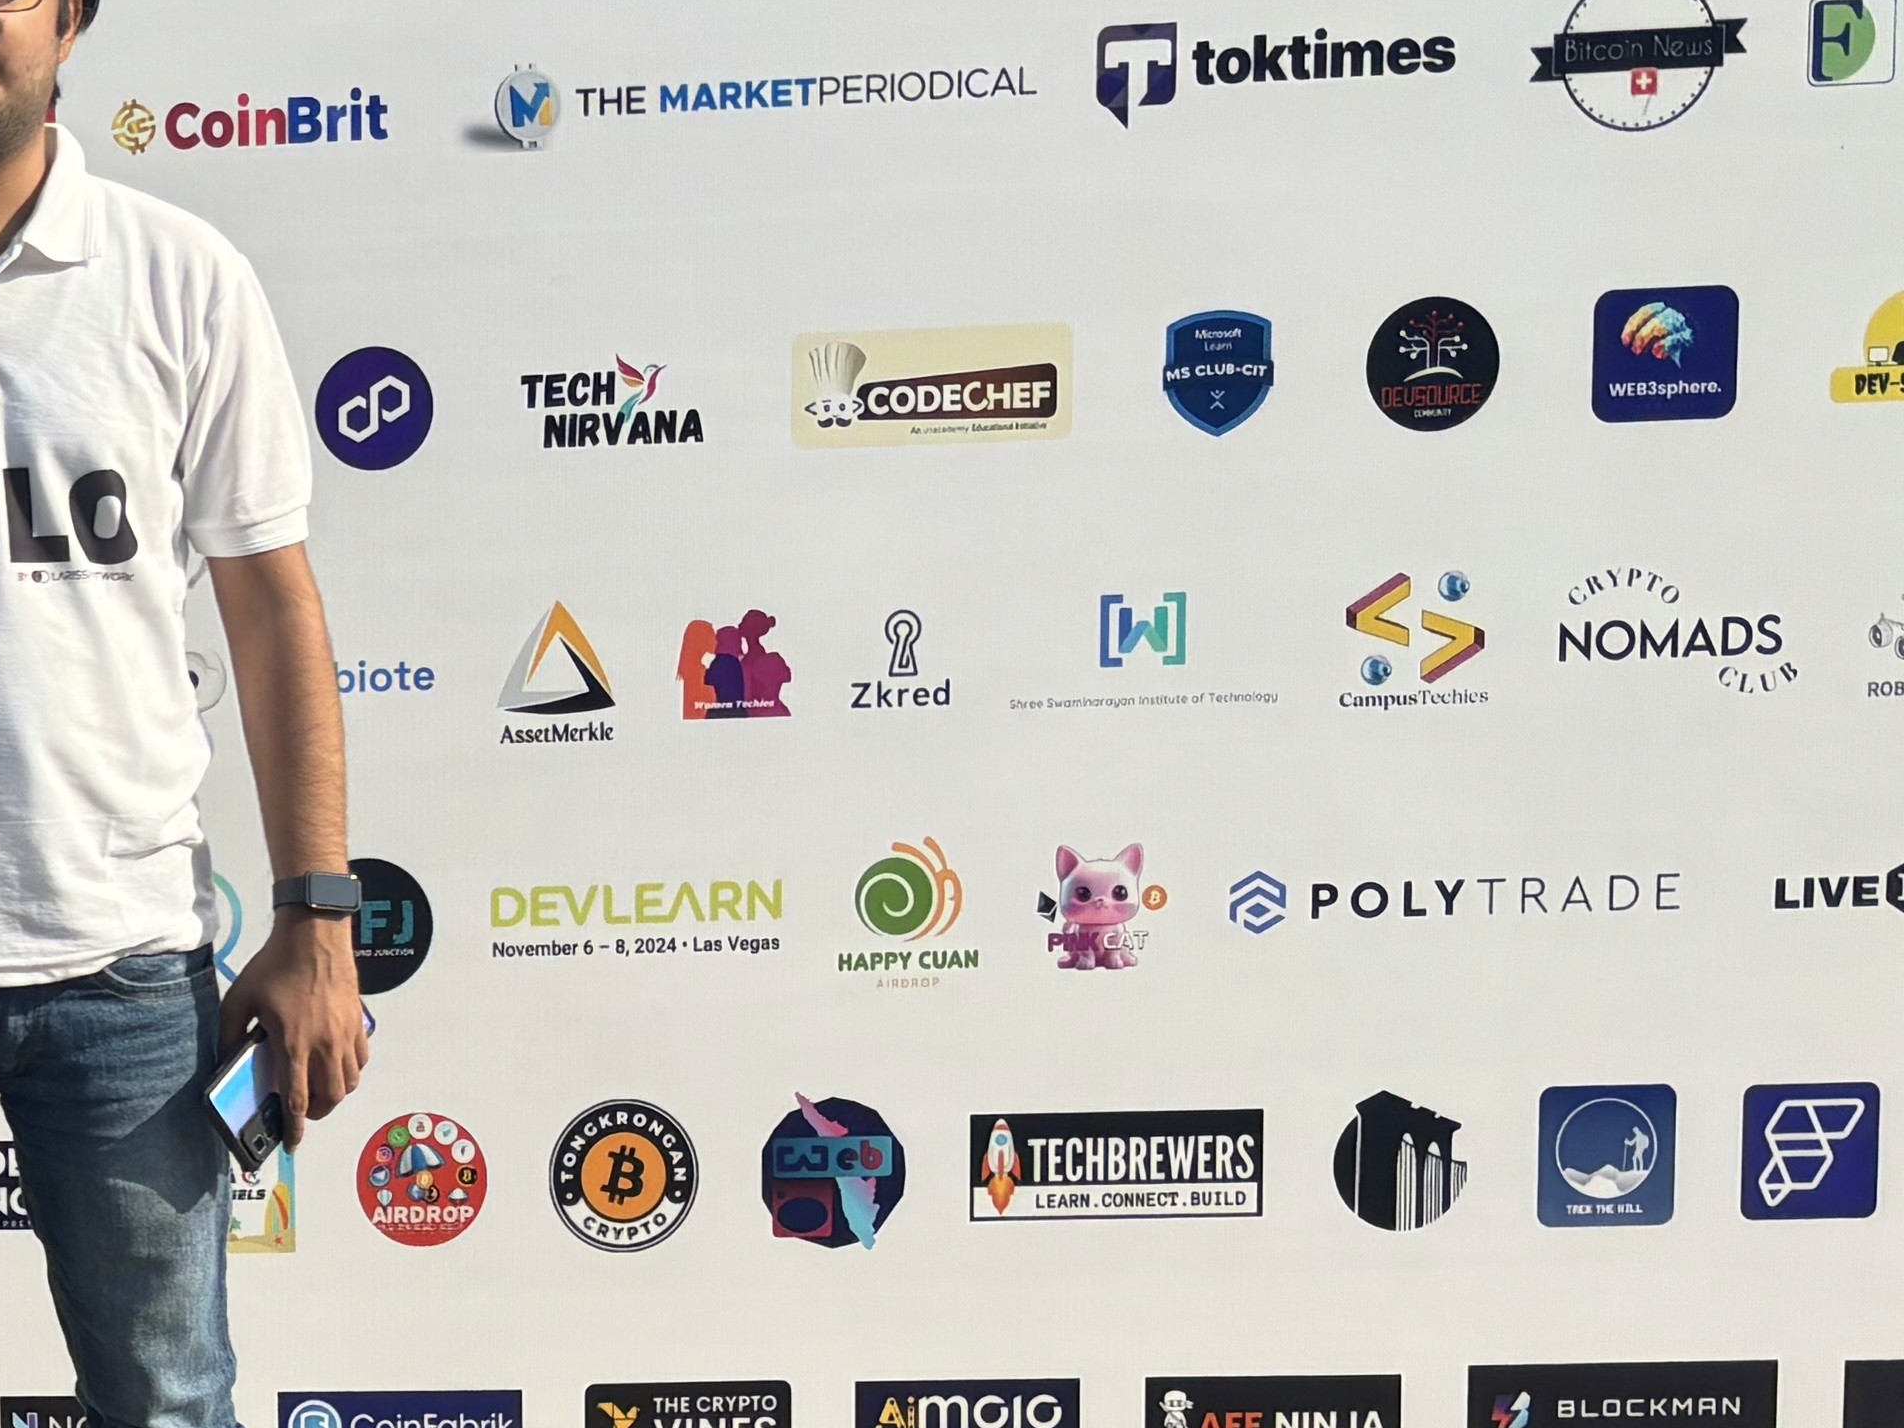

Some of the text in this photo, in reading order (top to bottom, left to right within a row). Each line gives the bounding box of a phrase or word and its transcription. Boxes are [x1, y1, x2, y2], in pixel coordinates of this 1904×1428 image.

[1193, 28, 1456, 87] toktimes
[1563, 34, 1645, 63] Bitcoin
[576, 66, 1037, 117] THE MARKETPERIODICAL
[165, 87, 389, 151] CoinBrit
[521, 373, 615, 408] TECH
[868, 378, 1052, 417] CODECHEF
[543, 408, 704, 449] NIRVANA
[1568, 567, 1681, 607] CRYPTO
[1559, 613, 1783, 663] NOMADS
[850, 679, 951, 710] Zkred
[1719, 661, 1799, 695] CLUB
[1339, 685, 1488, 711] CampusTechies
[500, 721, 615, 746] AssetMerkle
[491, 879, 783, 929] DEVLEARN
[1311, 873, 1680, 920] POLYTRADE
[492, 933, 780, 960] November 2024 Las Vegas
[837, 948, 979, 972] HAPPY CUAN
[1027, 1135, 1254, 1183] TECHBREWERS
[372, 1203, 475, 1224] AIRDROP
[582, 1212, 668, 1241] CRYPTO
[653, 1394, 777, 1413] THE CRYPTO
[1557, 1396, 1741, 1420] BLOCKMAN
